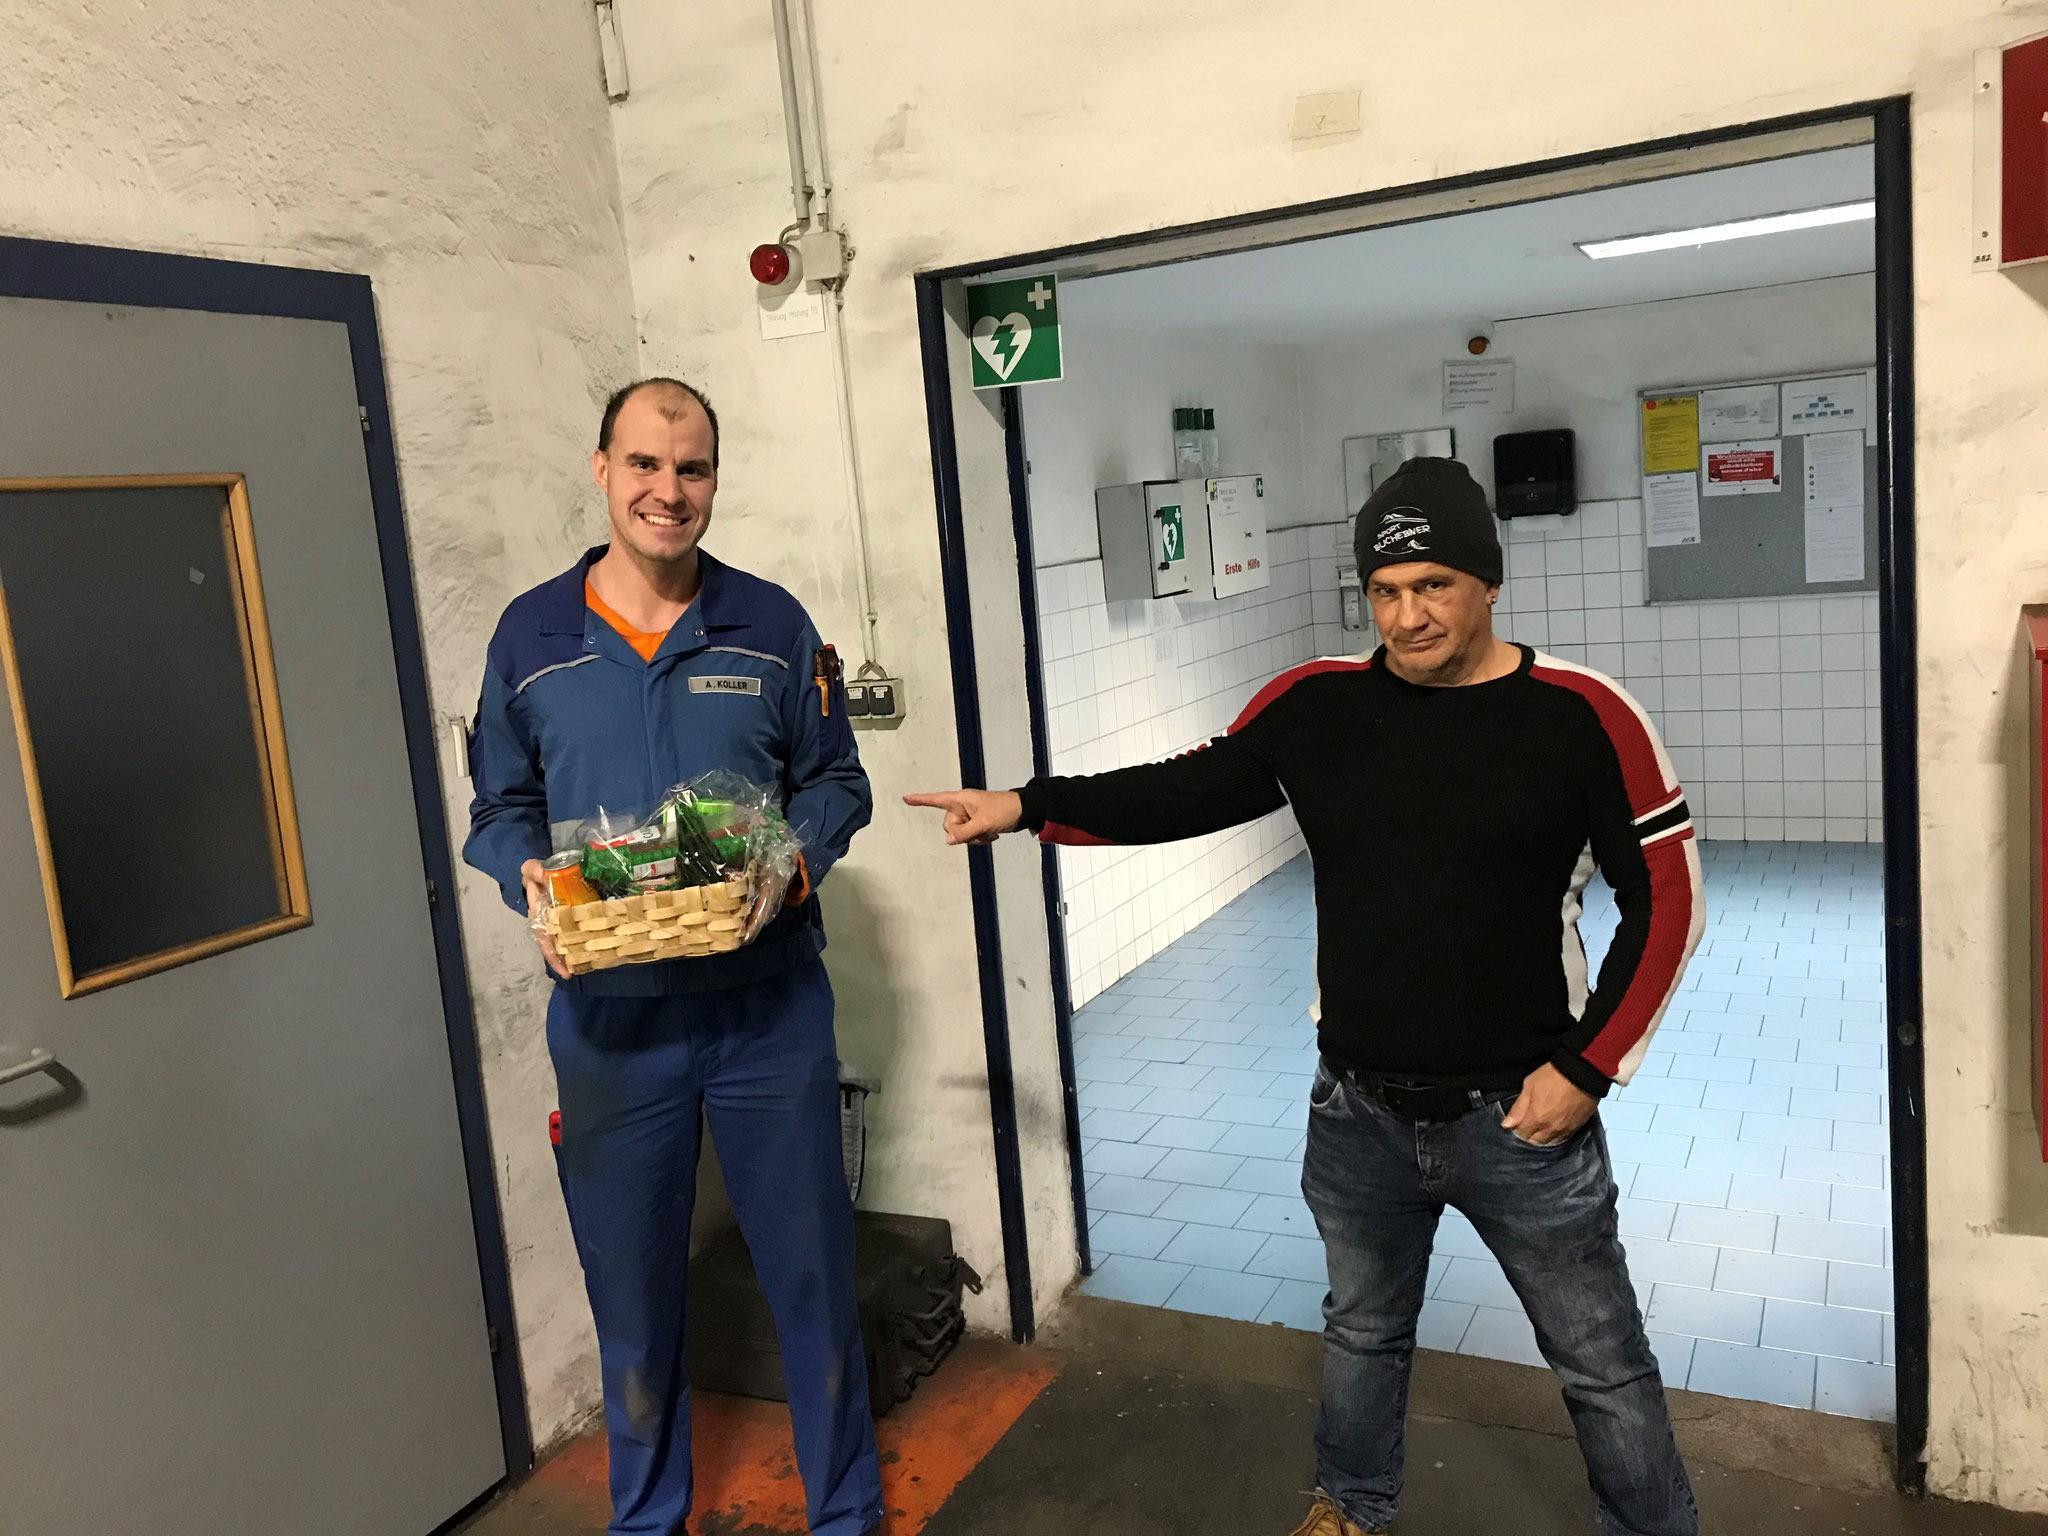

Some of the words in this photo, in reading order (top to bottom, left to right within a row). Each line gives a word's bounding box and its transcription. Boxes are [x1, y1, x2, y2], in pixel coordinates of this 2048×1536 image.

[1376, 523, 1401, 540] SPORT
[1225, 562, 1242, 575] Erste
[1247, 558, 1260, 570] Hilfe
[717, 680, 748, 690] KOLLER
